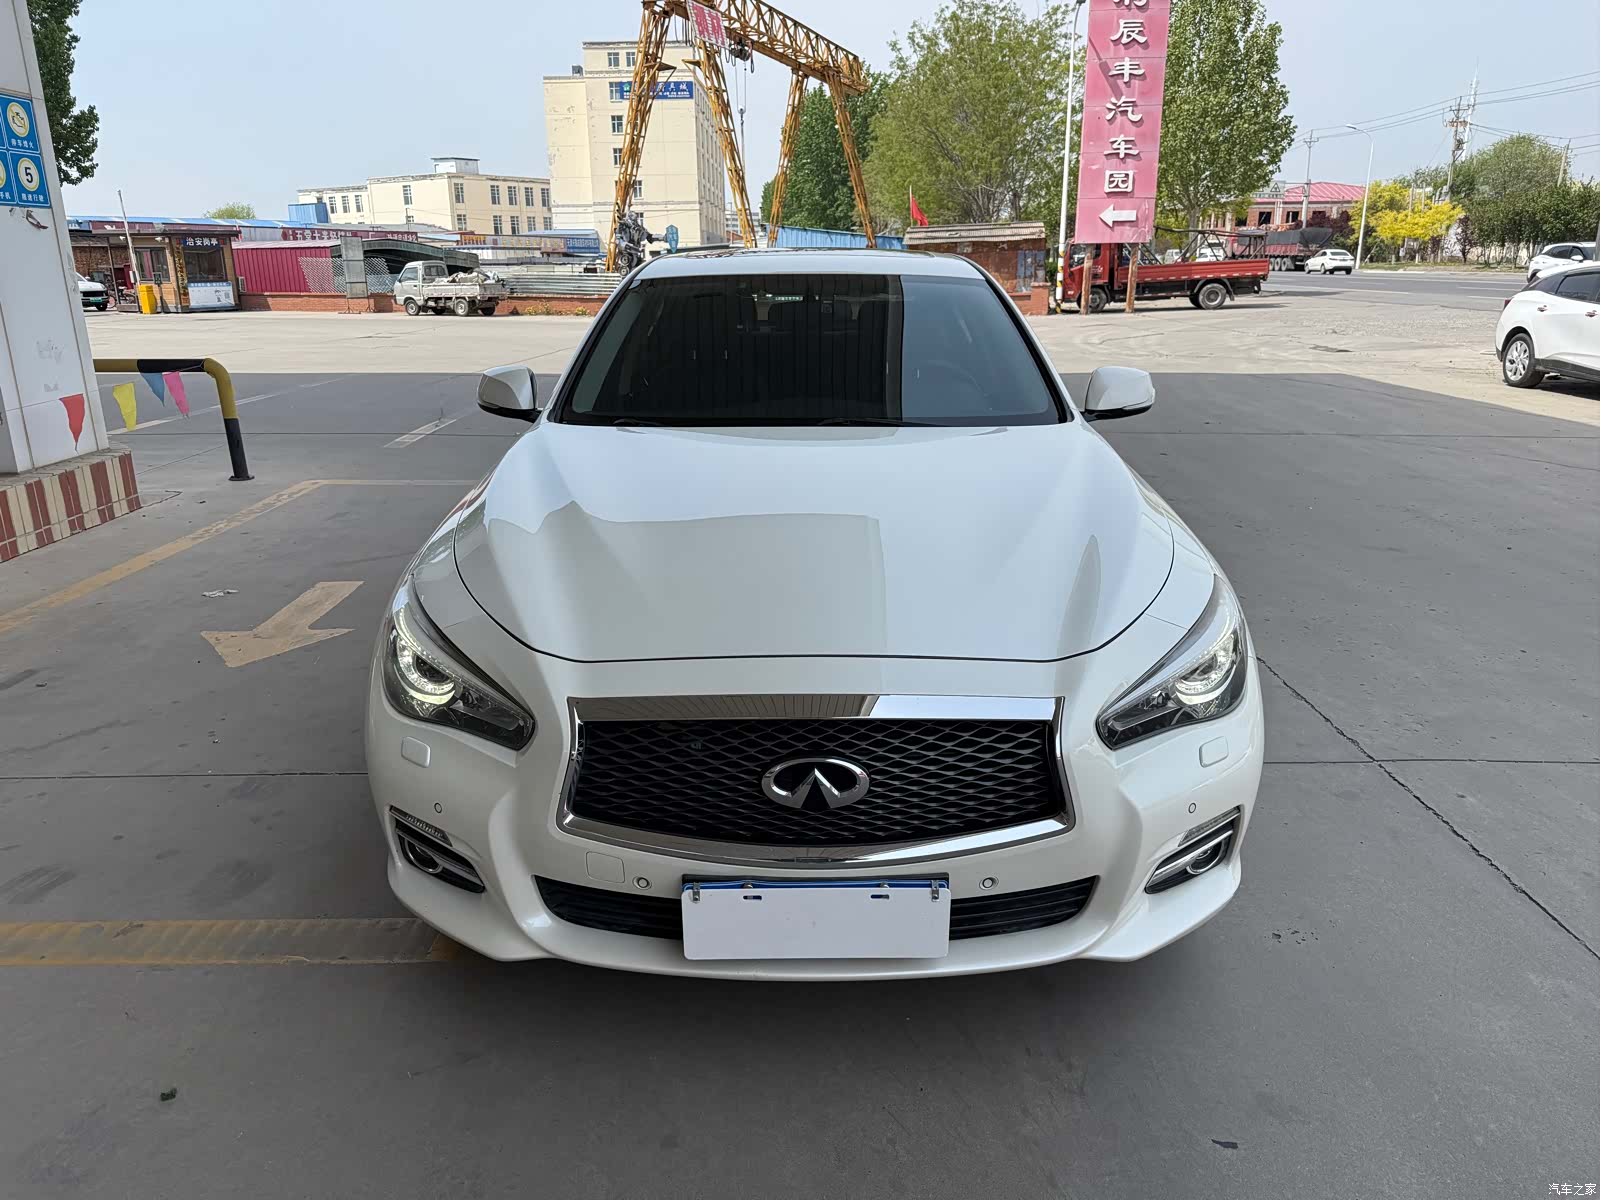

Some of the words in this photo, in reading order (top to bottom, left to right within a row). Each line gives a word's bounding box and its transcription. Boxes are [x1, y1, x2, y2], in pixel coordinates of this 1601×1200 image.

[24, 167, 34, 183] 5
[186, 237, 218, 246] 治安岗亭
